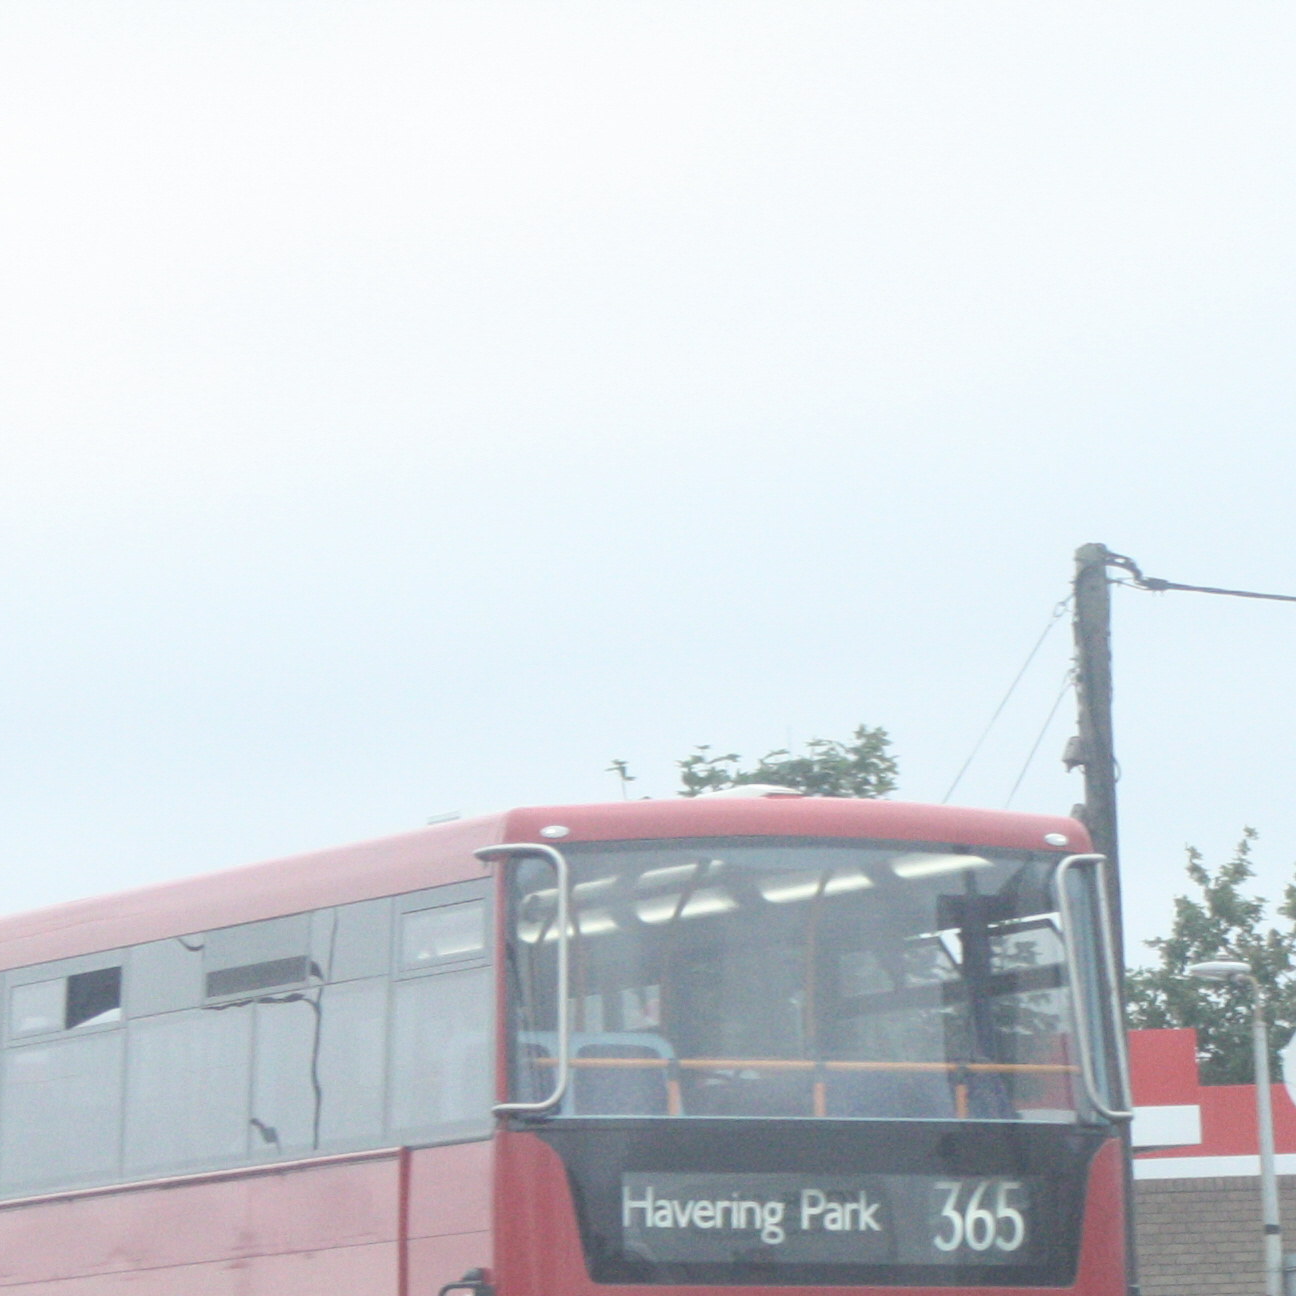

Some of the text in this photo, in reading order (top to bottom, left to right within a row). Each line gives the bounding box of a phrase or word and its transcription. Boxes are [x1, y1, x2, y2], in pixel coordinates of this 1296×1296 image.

[622, 1181, 1025, 1251] Havering Park 365
